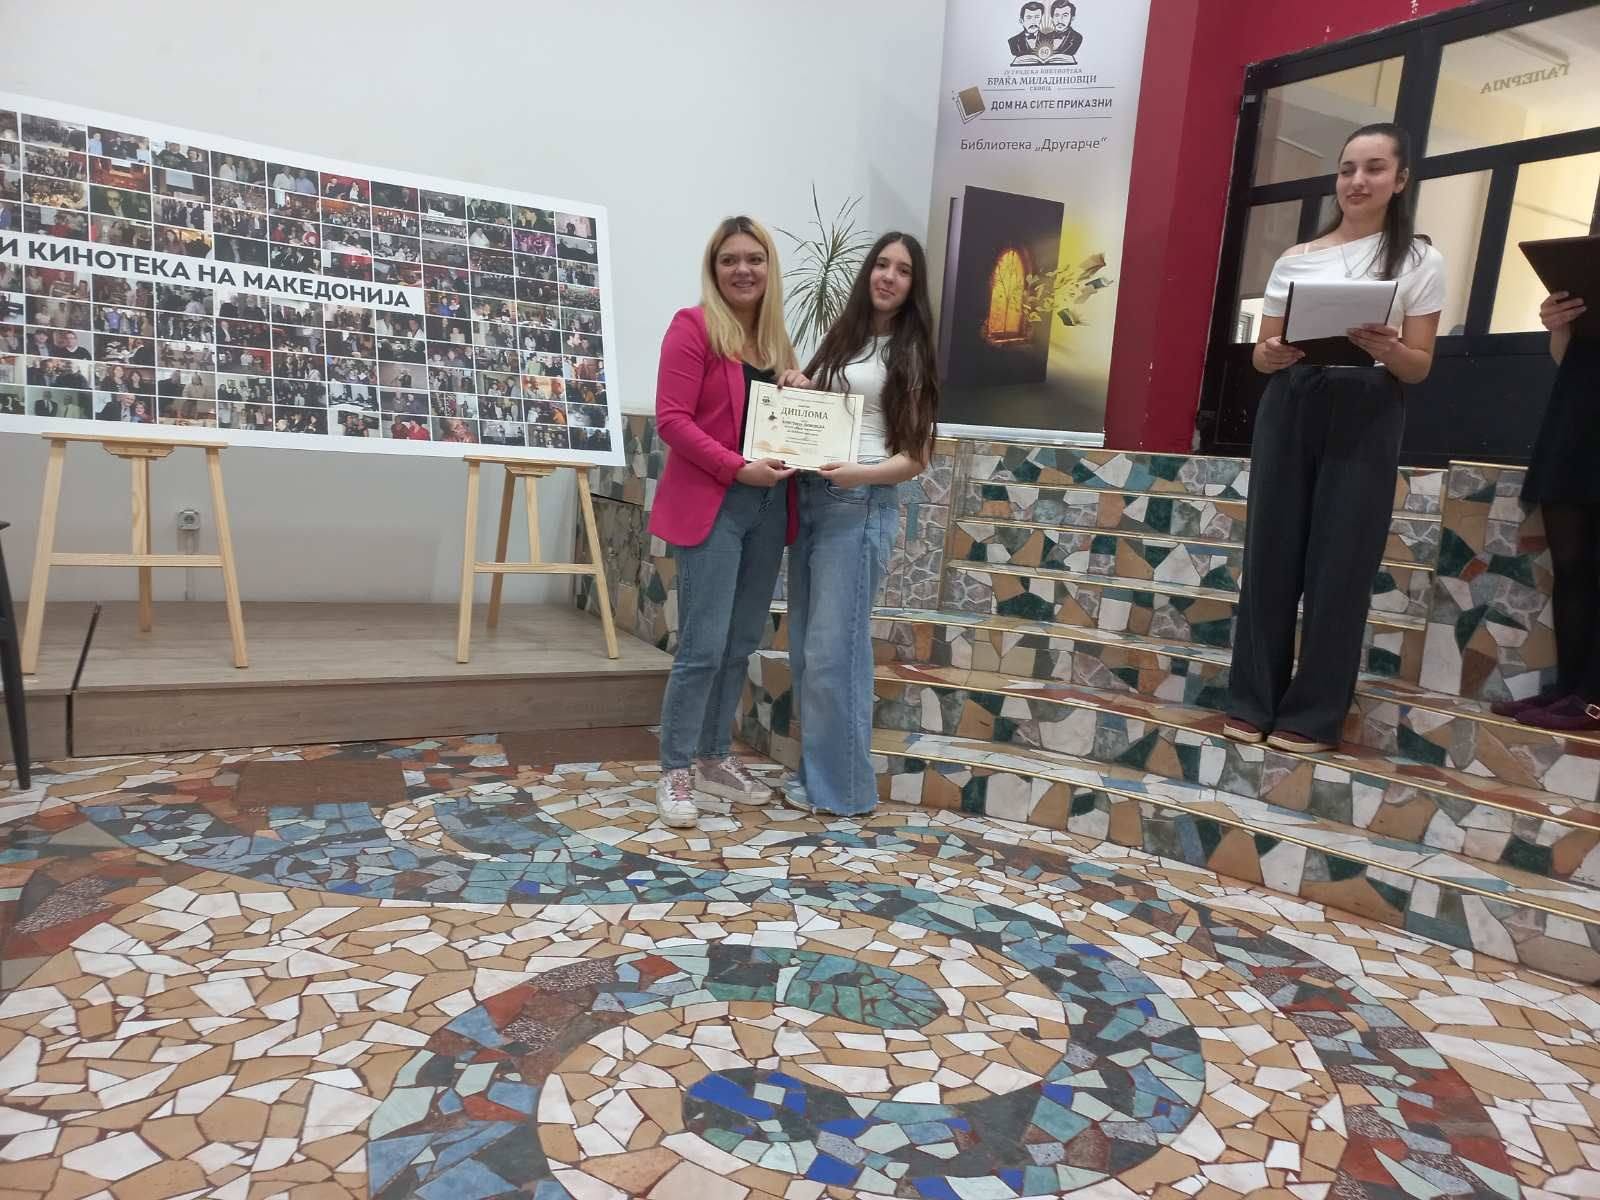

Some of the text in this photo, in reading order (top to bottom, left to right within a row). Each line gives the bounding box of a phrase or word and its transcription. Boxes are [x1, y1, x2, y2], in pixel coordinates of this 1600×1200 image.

[987, 75, 1097, 86] БРАЌА МИЛАДИНОВЦИ
[991, 98, 1113, 111] ДОМ НА СИТЕ ПРИКАЗНИ
[960, 138, 1032, 150] Библиотека
[0, 236, 410, 308] И КИНОТЕКА НА МАКЕДОНИЈА
[781, 407, 828, 420] ДИПЛОМА
